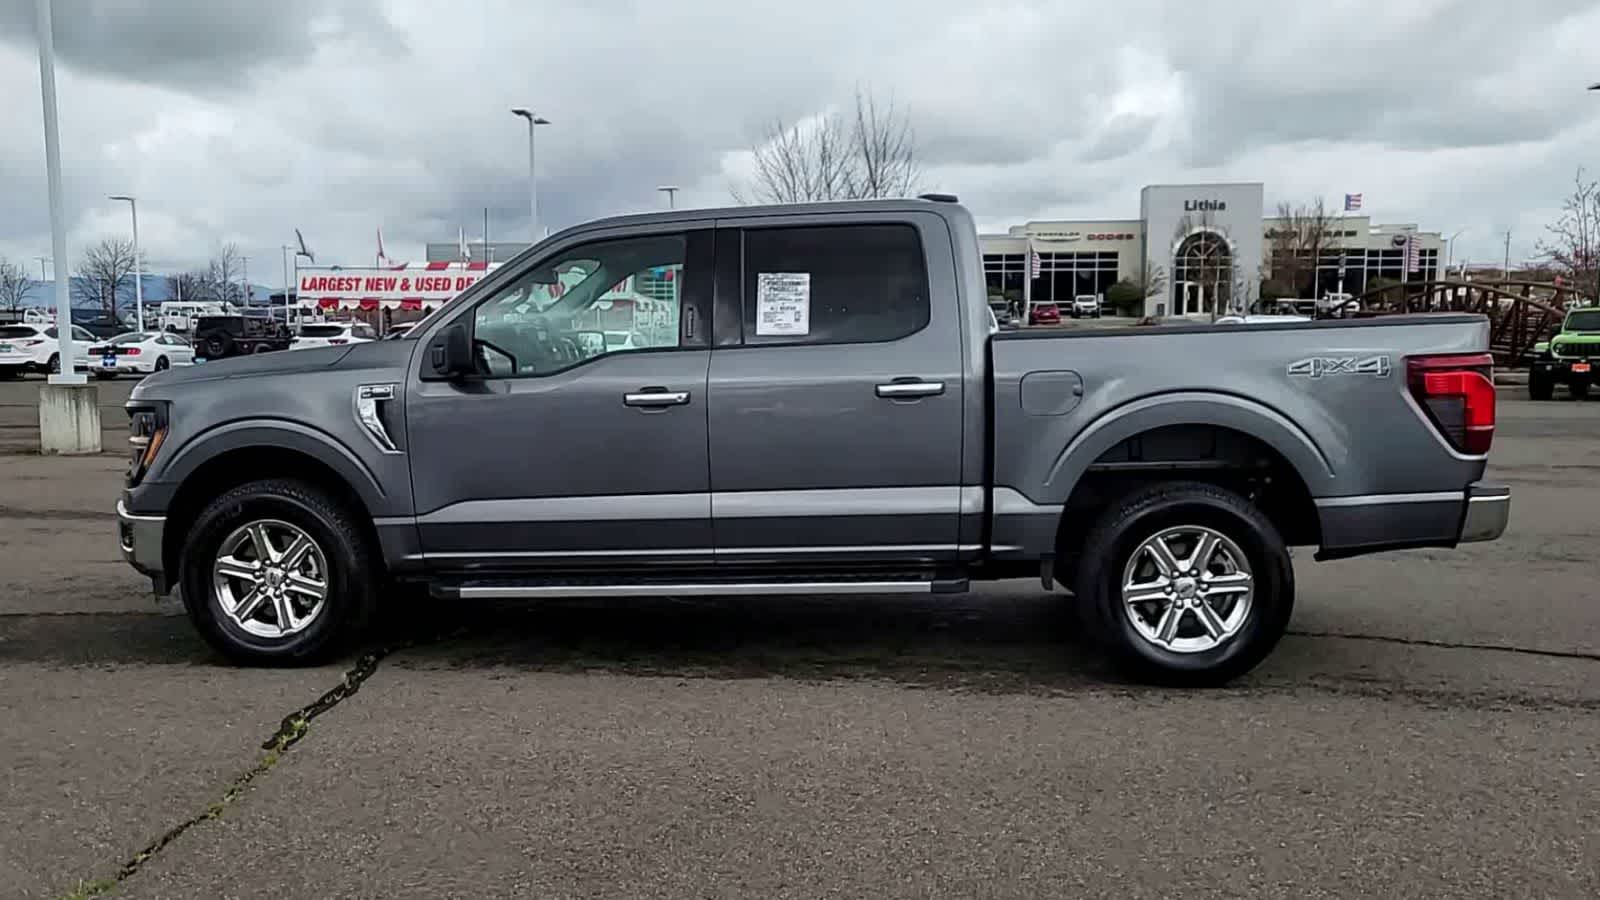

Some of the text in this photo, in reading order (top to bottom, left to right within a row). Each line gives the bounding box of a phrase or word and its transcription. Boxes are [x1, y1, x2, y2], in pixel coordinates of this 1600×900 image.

[1184, 199, 1226, 211] Lithia
[1087, 233, 1135, 241] DODGE
[301, 277, 480, 291] LARGEST NEW & USED DE
